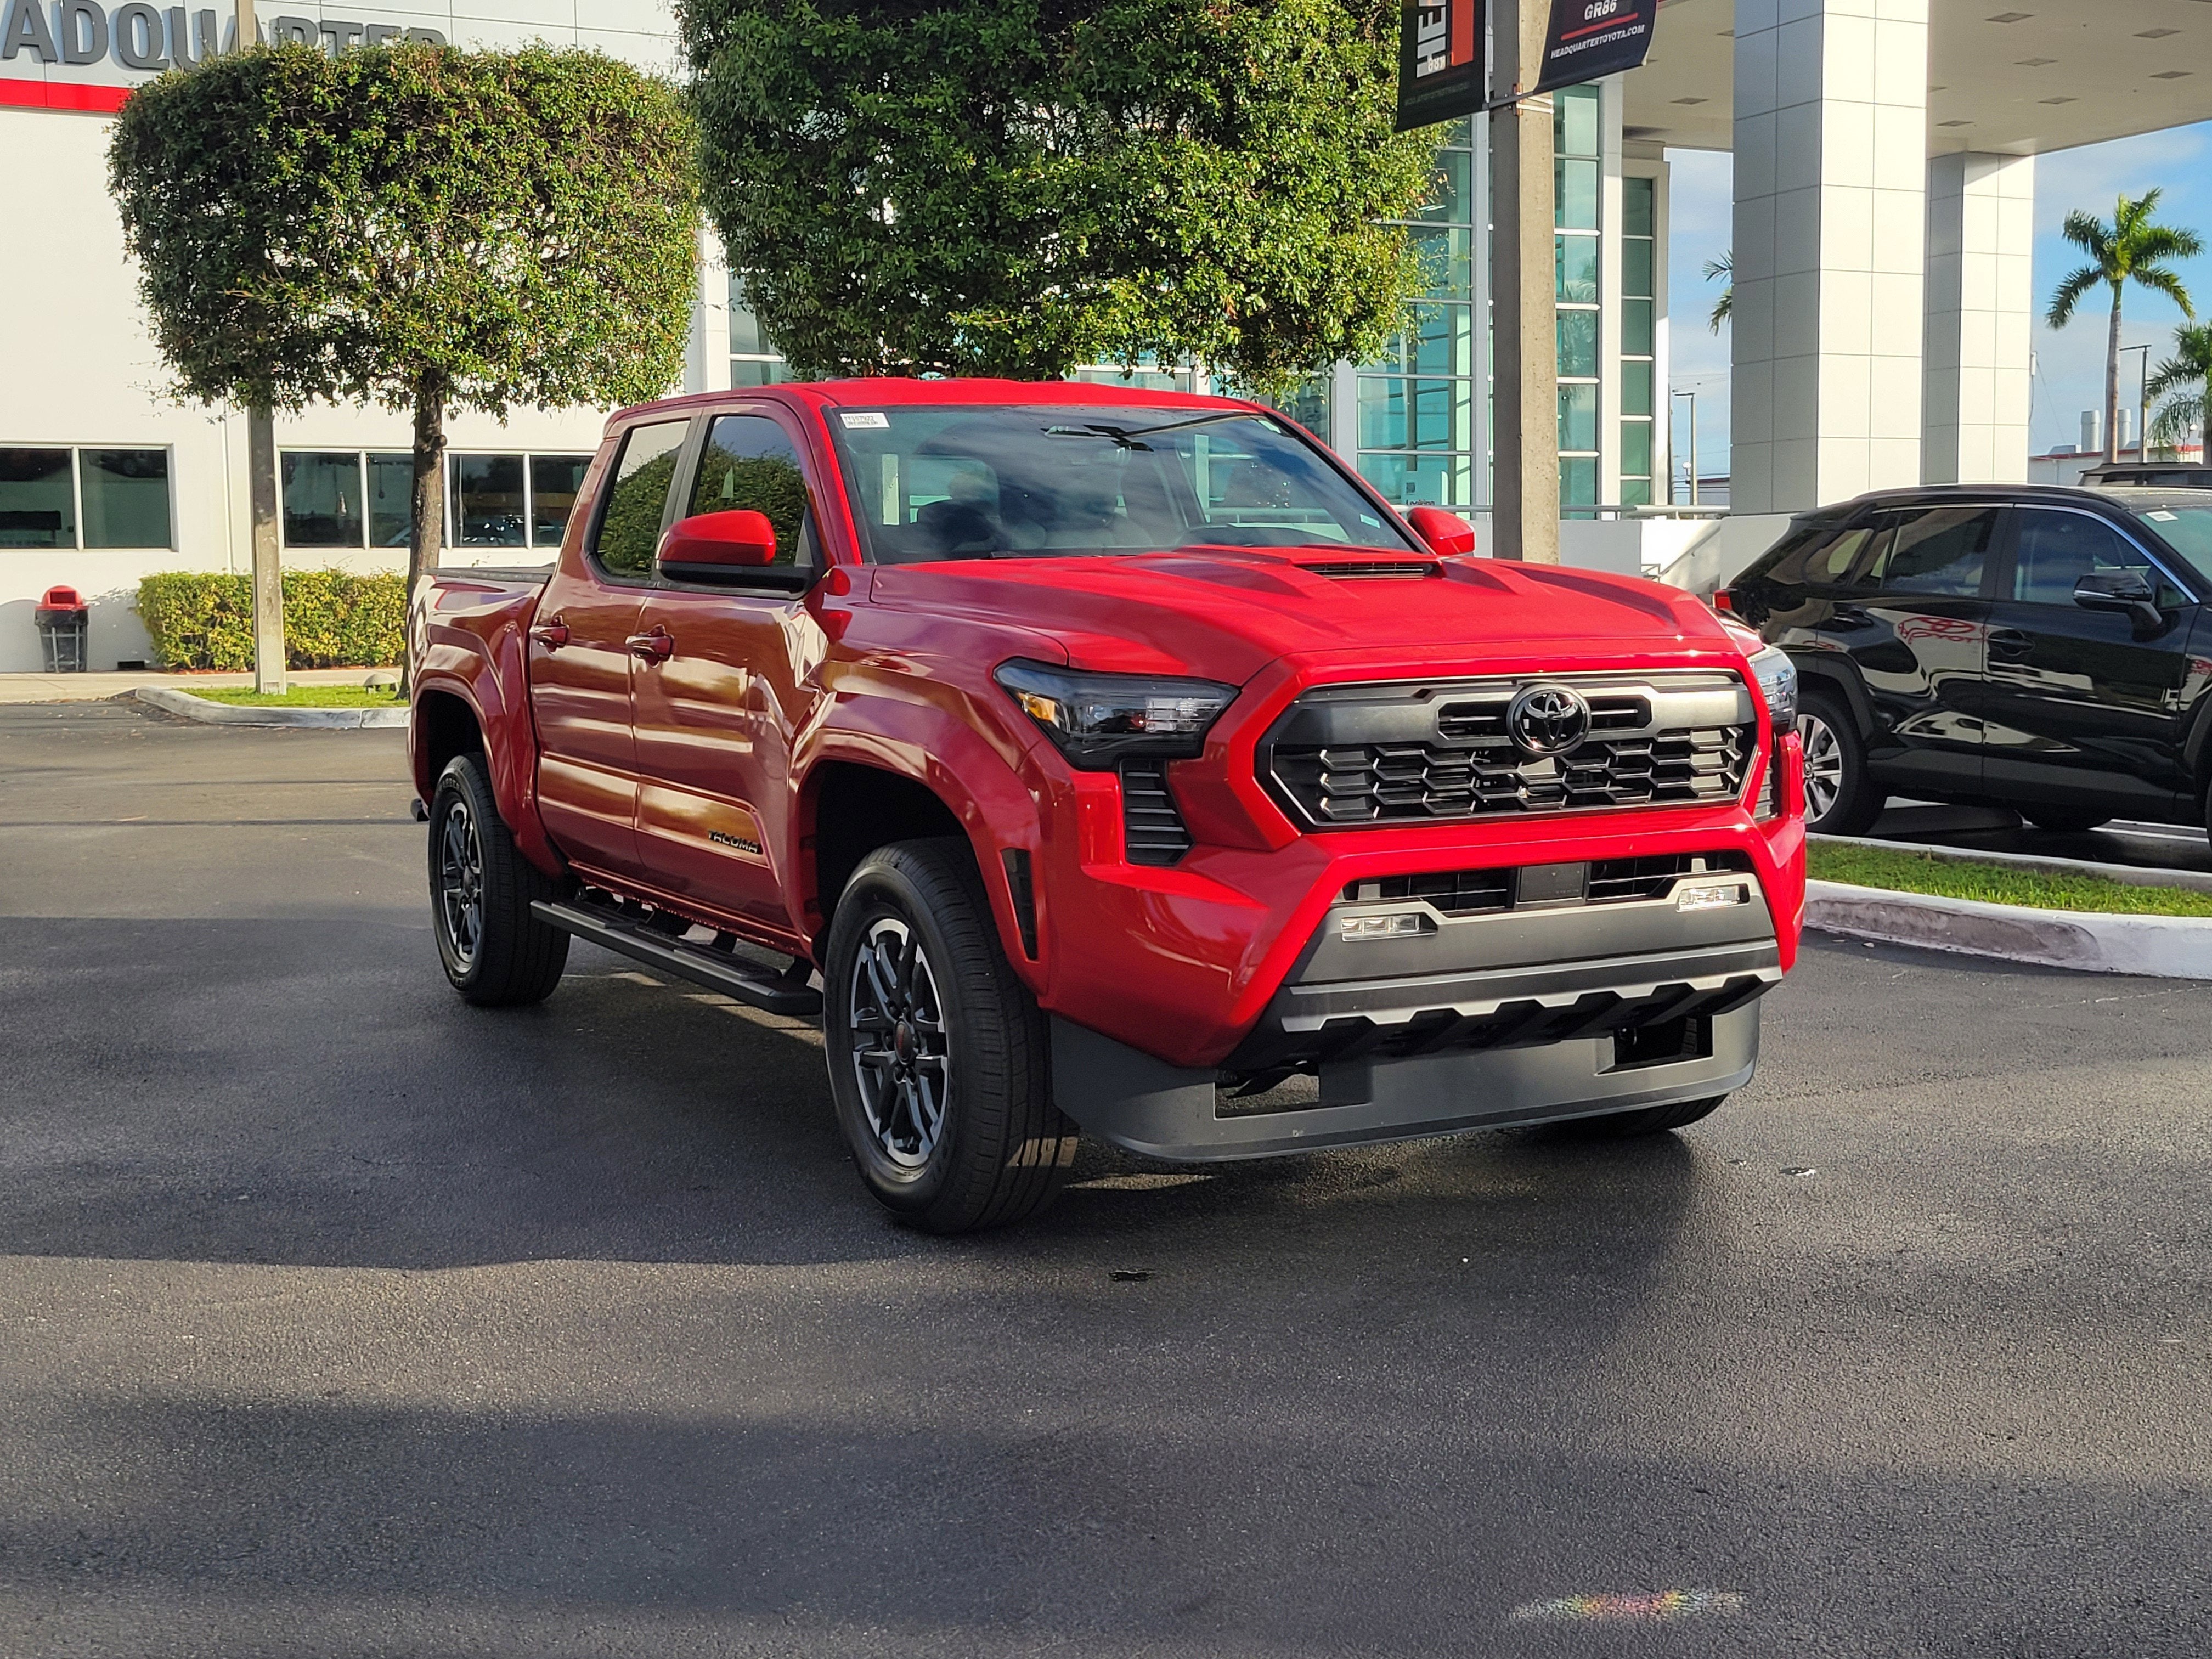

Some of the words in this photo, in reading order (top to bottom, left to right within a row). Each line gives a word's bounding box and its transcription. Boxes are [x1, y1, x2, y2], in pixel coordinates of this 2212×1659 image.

[1584, 0, 1616, 20] GR86
[1417, 0, 1446, 78] HE
[1550, 24, 1645, 59] HEADQUARTERTOYOTA.COM
[708, 830, 758, 854] TACOMA
